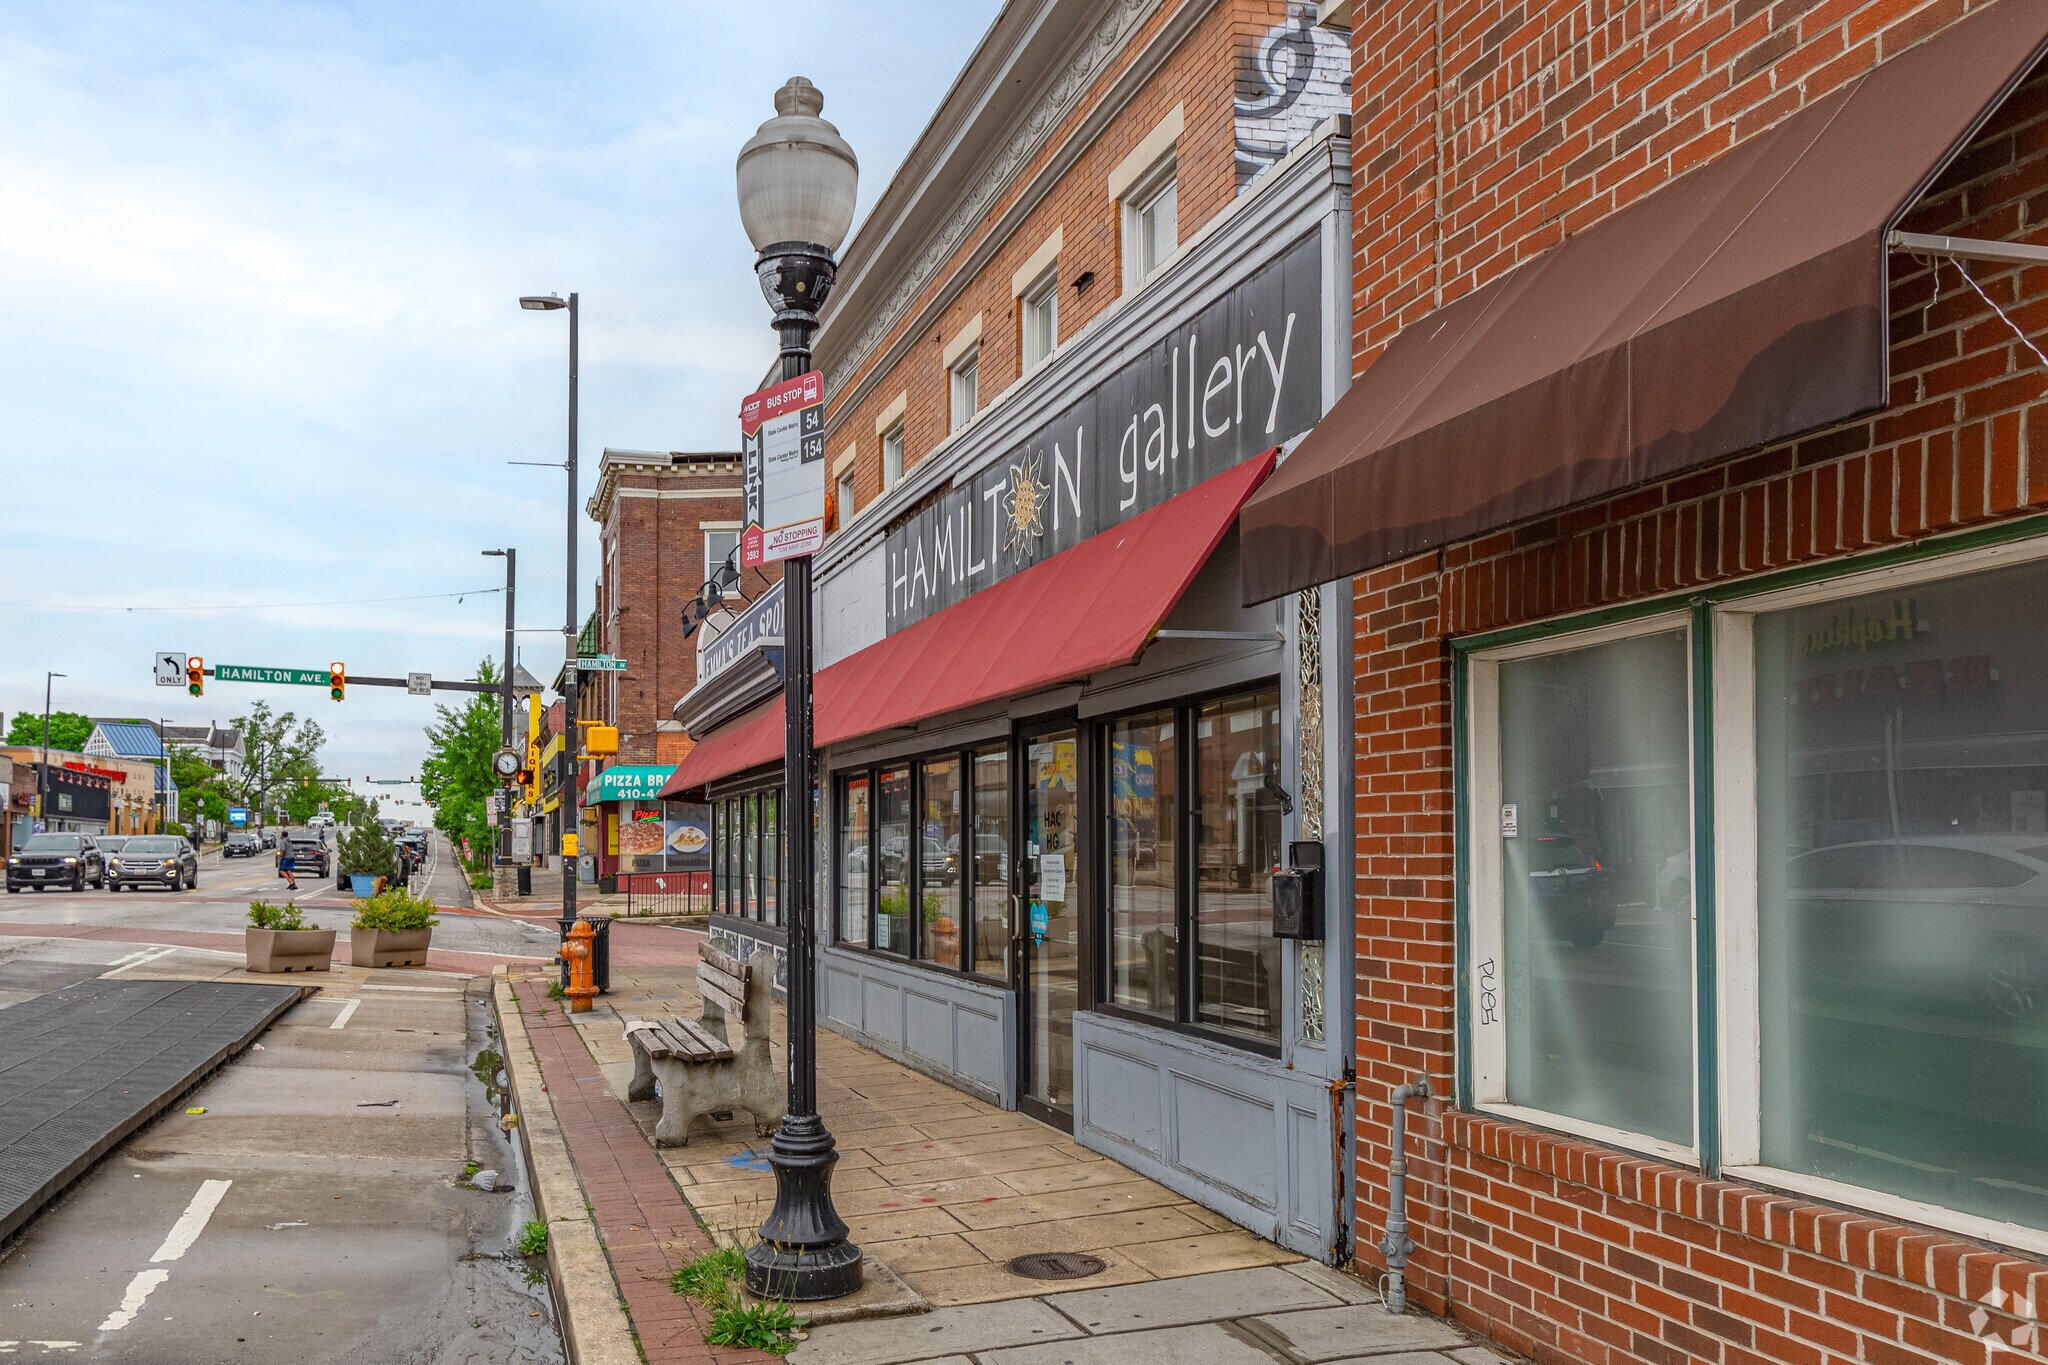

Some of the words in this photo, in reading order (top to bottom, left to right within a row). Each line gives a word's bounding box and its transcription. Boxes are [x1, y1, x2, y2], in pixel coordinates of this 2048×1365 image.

[766, 395, 781, 409] BUS
[783, 387, 803, 404] STOP
[1119, 312, 1296, 511] gallery
[806, 410, 819, 429] 54
[776, 425, 788, 433] Center
[776, 452, 788, 461] Center
[788, 449, 799, 457] Metro
[803, 438, 823, 459] 154
[773, 534, 784, 544] NO
[784, 526, 818, 542] STOPPING
[788, 543, 801, 551] AWAY
[800, 540, 813, 549] ZONE
[705, 638, 734, 678] EMMA'S
[736, 621, 754, 656] TEA
[581, 659, 616, 669] HAMILTON
[160, 676, 182, 684] ONLY
[221, 667, 292, 682] HAMILTON
[299, 673, 326, 684] AVE.
[527, 742, 536, 798] LIQURS
[604, 774, 642, 787] PIZZA
[617, 788, 661, 799] 410-4
[634, 809, 660, 820] Pizza
[1044, 809, 1061, 828] HAC
[1046, 832, 1059, 850] HG
[632, 858, 651, 867] PIZZA
[667, 858, 710, 867] Quesadillas
